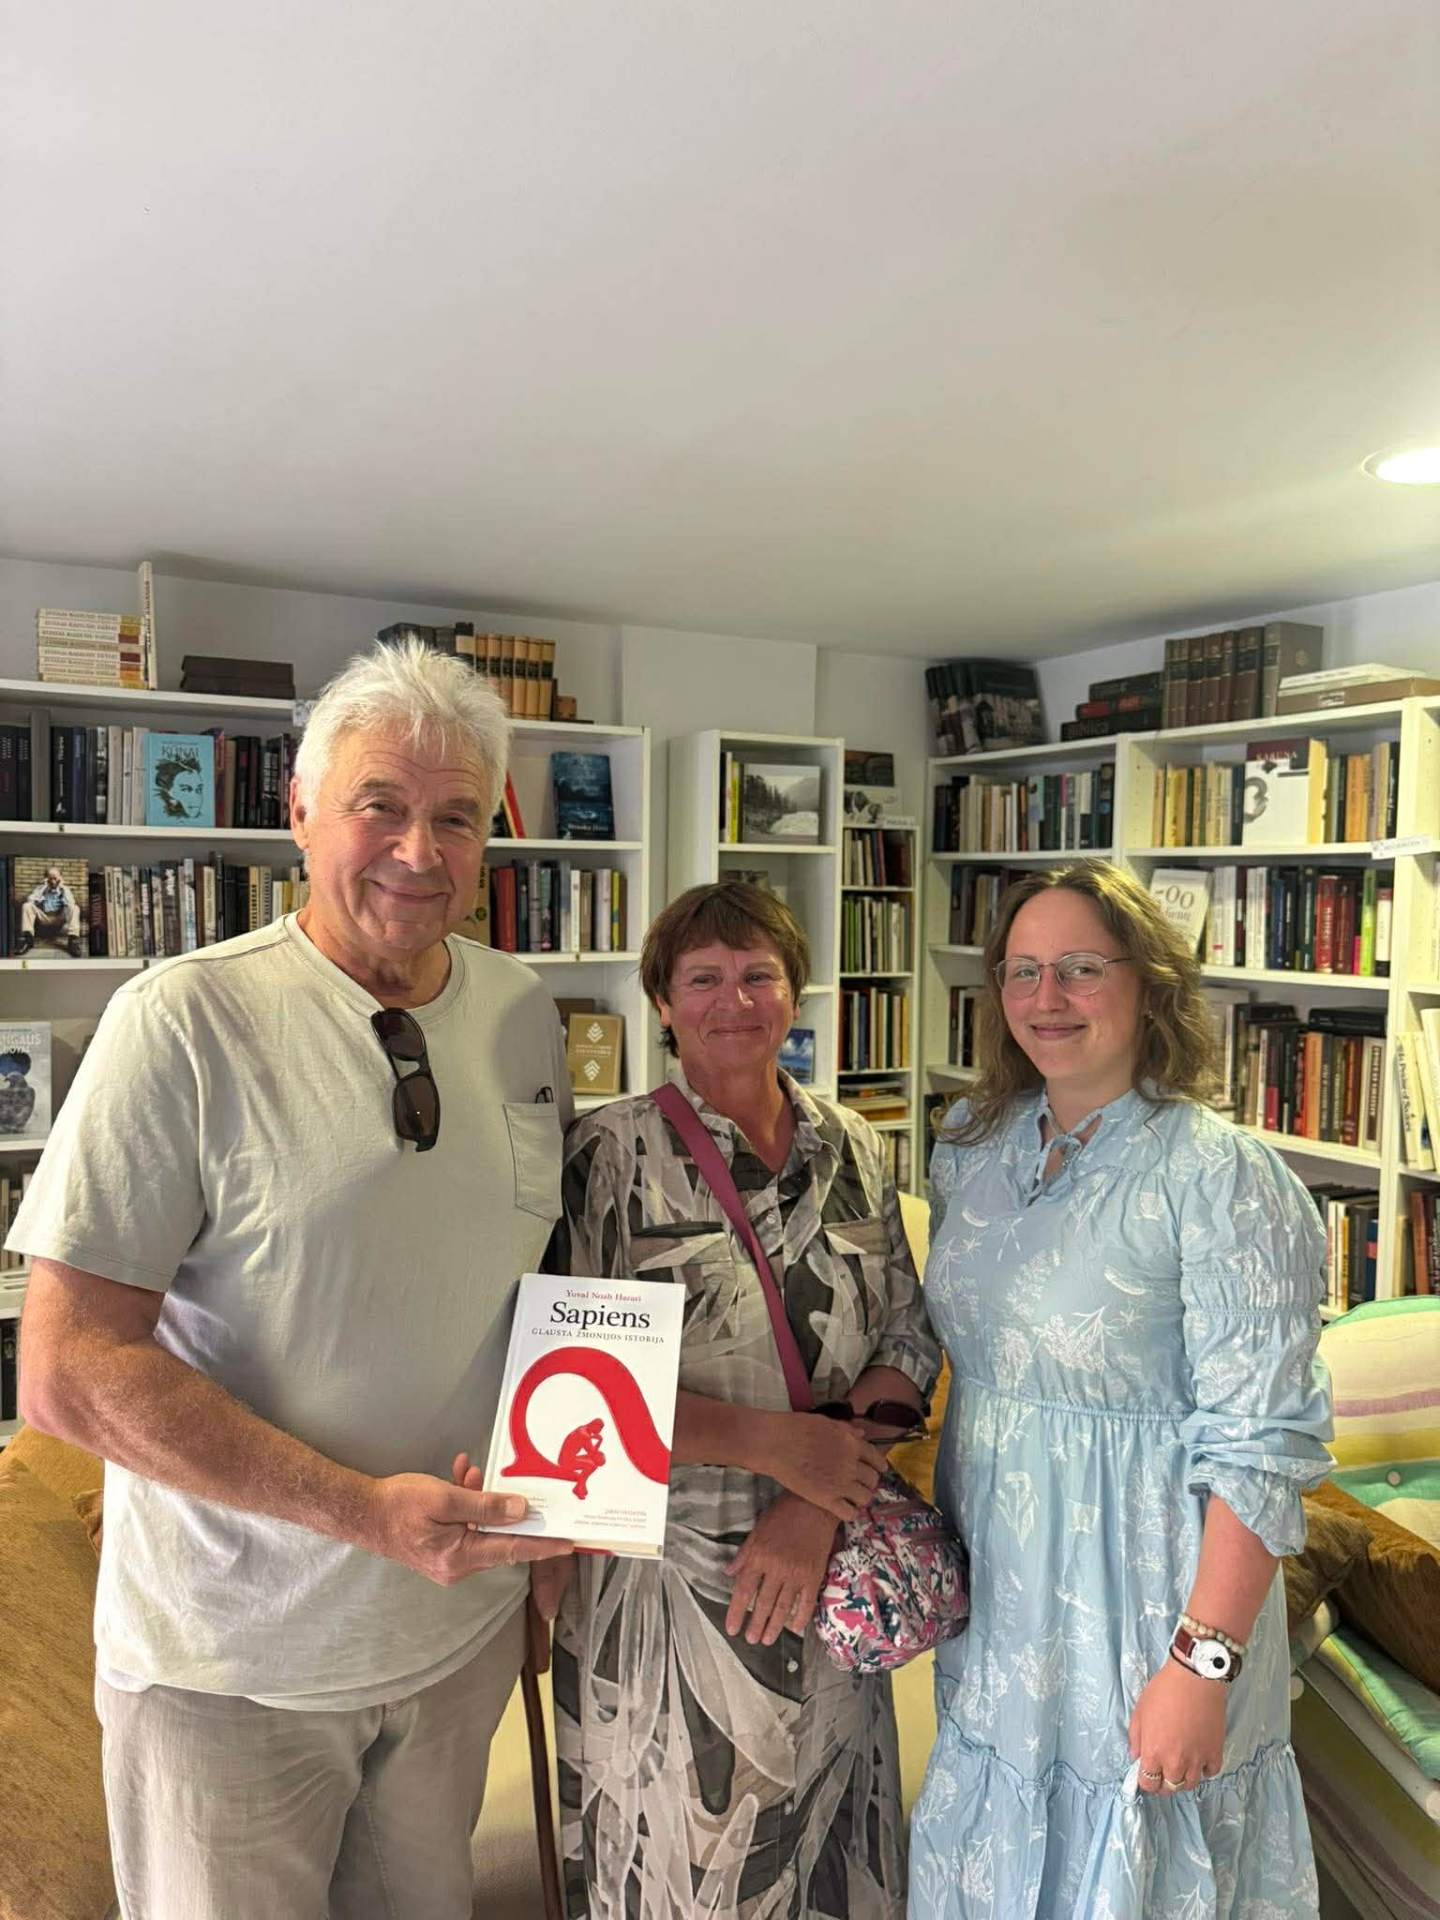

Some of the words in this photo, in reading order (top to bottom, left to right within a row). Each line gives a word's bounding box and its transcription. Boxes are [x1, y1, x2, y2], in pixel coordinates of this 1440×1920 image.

[566, 1289, 589, 1299] Yuval
[592, 1291, 612, 1300] Noah
[615, 1293, 642, 1302] Harari
[550, 1301, 651, 1330] Sapiens
[531, 1327, 573, 1337] GLAUSTA
[576, 1330, 622, 1341] ŽMONIJOS
[625, 1334, 665, 1344] ISTORIJA
